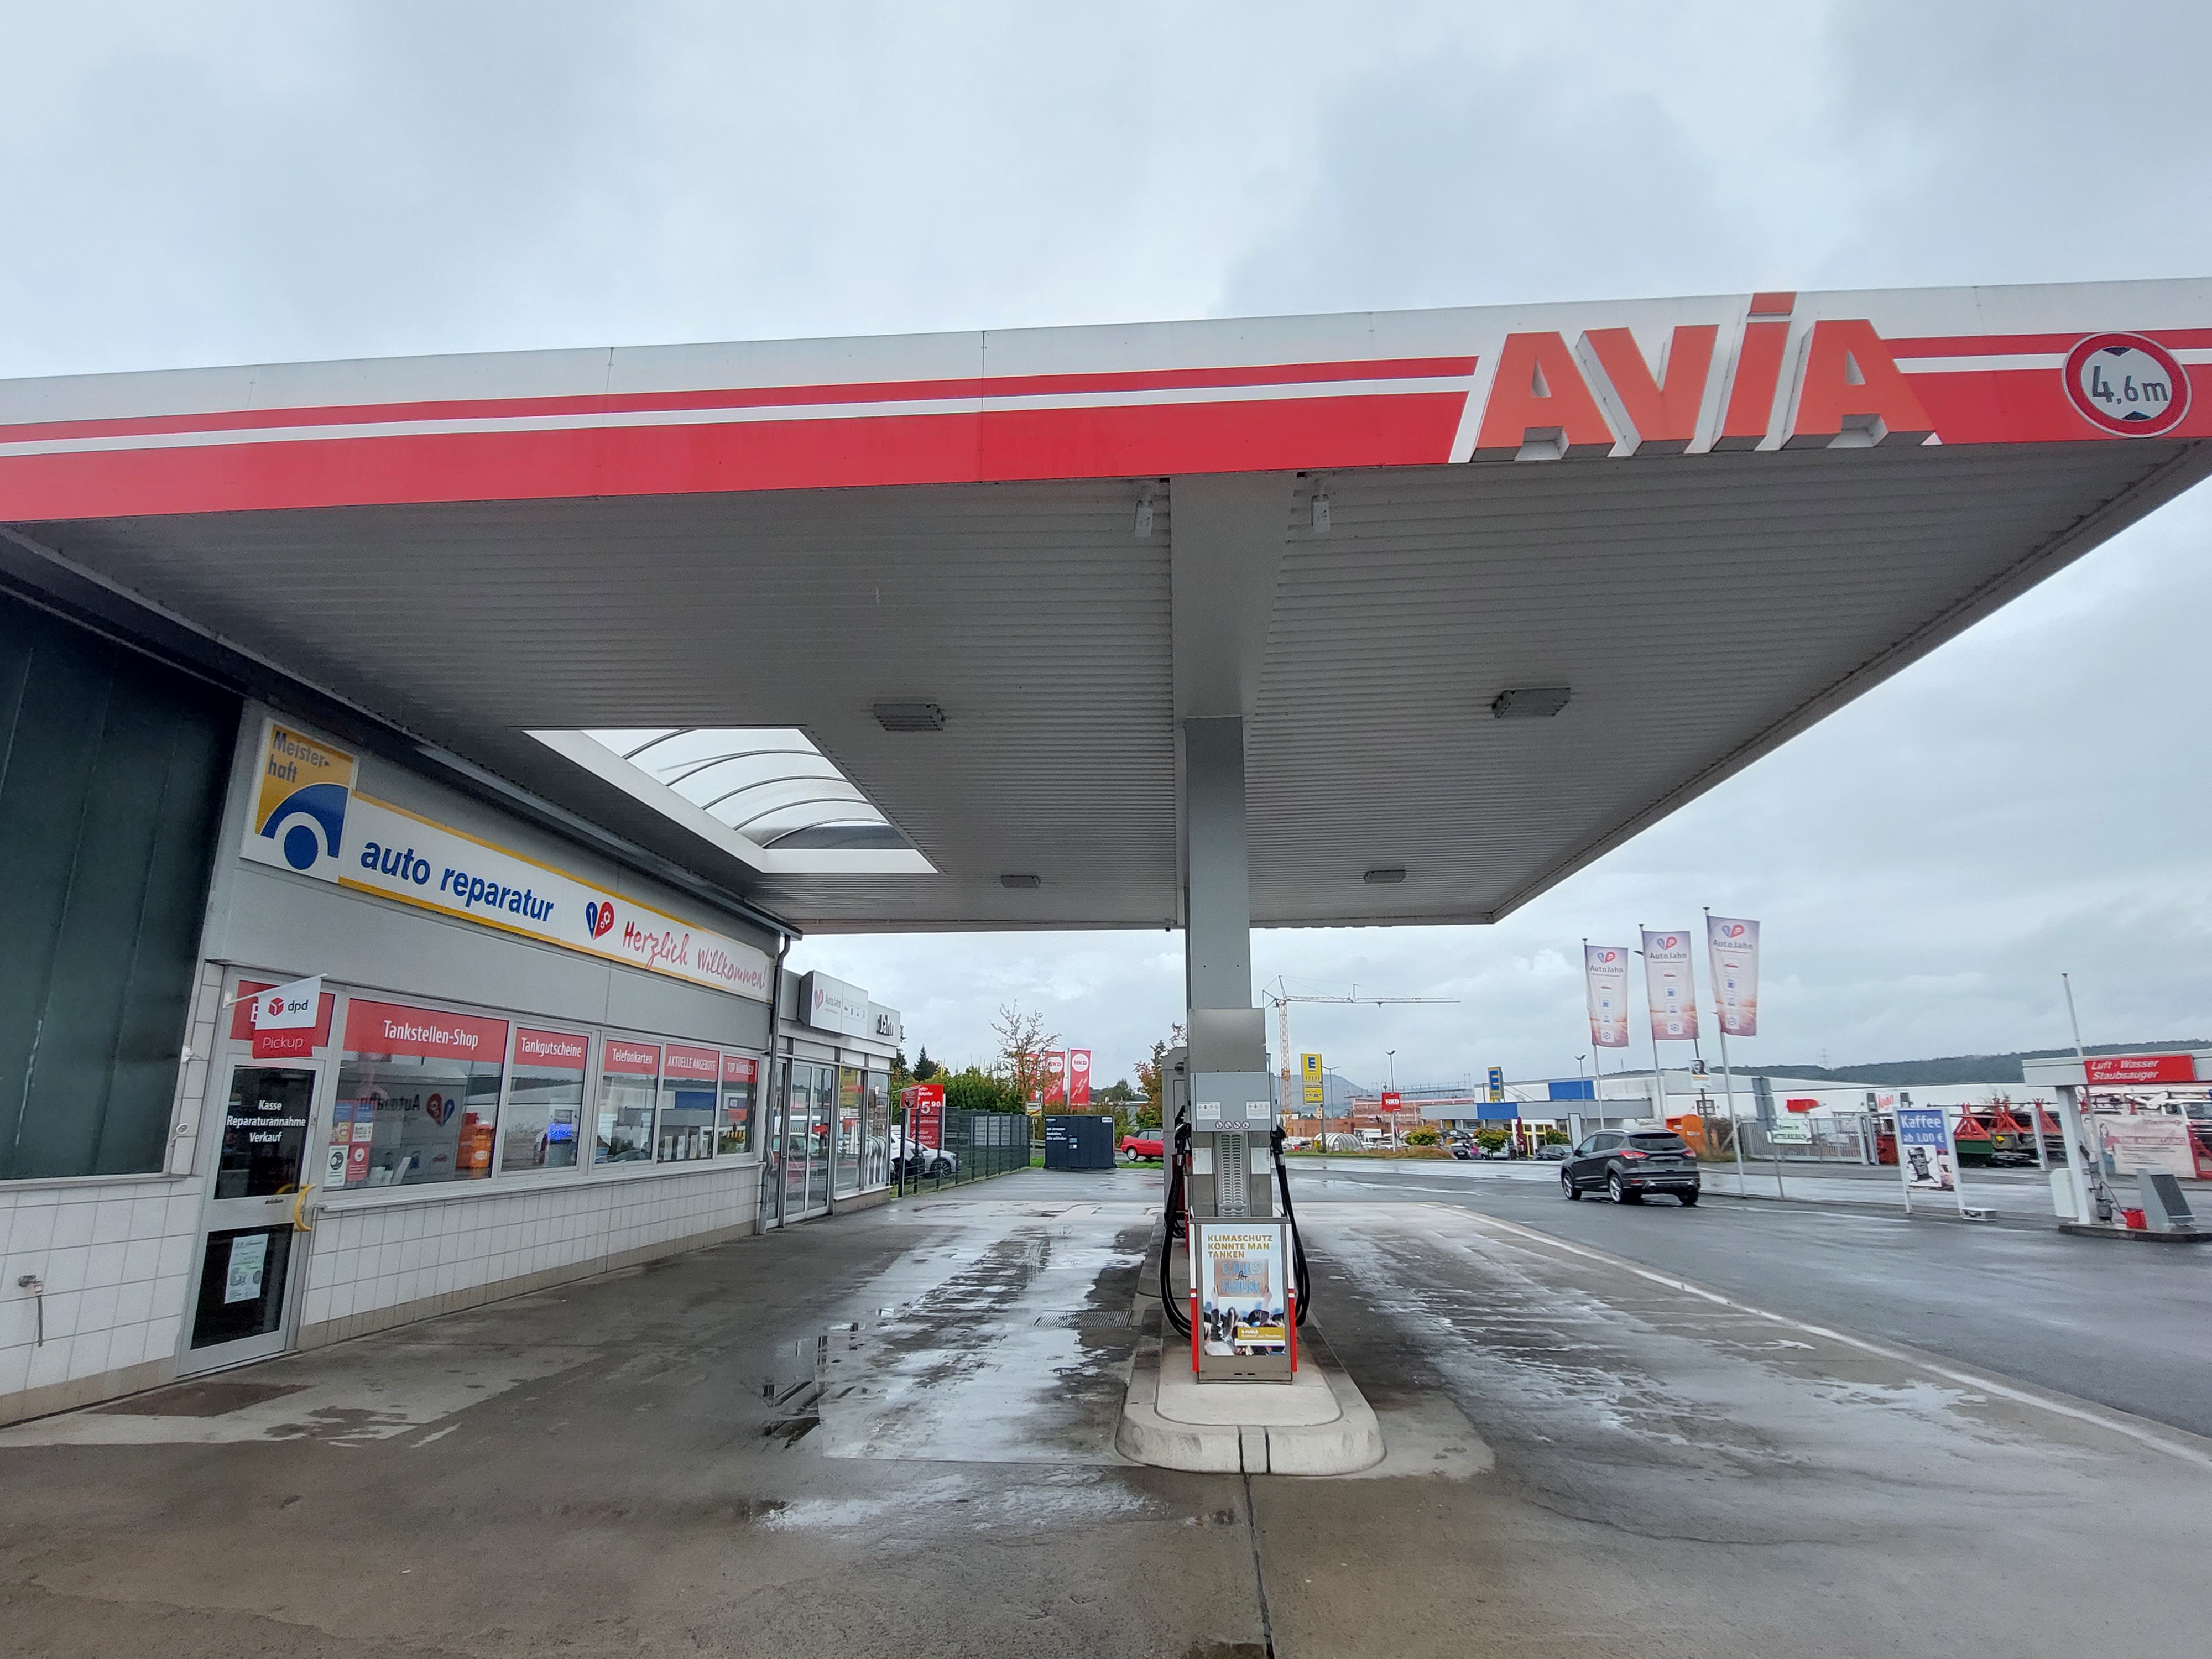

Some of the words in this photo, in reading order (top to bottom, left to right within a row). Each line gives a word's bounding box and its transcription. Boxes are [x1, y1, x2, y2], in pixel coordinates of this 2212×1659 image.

[272, 731, 330, 768] Meister-
[267, 754, 297, 784] haft
[360, 842, 430, 885] auto
[440, 866, 555, 922] reparatur
[1713, 940, 1754, 950] AutoJahn
[623, 921, 688, 969] Herzlich
[697, 947, 766, 990] Willkommen!
[1590, 965, 1624, 974] AutoJahn
[288, 999, 309, 1014] dpd
[384, 1020, 479, 1050] Tankstellen-Shop
[263, 1036, 304, 1050] Pickup
[521, 1037, 582, 1058] Tankgutscheine
[612, 1048, 653, 1065] Telefonkarten
[667, 1056, 692, 1068] AKTUELLE
[693, 1058, 716, 1071] ANGEBOTE
[1308, 1057, 1316, 1069] E
[2091, 1061, 2113, 1070] Luft
[2120, 1060, 2159, 1069] Wasser
[2093, 1071, 2159, 1081] Staubsauger
[258, 1100, 283, 1112] Kasse
[1878, 1094, 1894, 1111] logo
[227, 1115, 306, 1129] Reparaturannahme
[1901, 1115, 1942, 1128] Kaffee
[249, 1131, 283, 1144] Verkauf
[1903, 1133, 1914, 1142] ab
[1938, 1133, 1945, 1143] €
[1208, 1242, 1245, 1250] KÖNNTE
[1235, 1270, 1248, 1281] for
[1222, 1279, 1260, 1294] FUTURE
